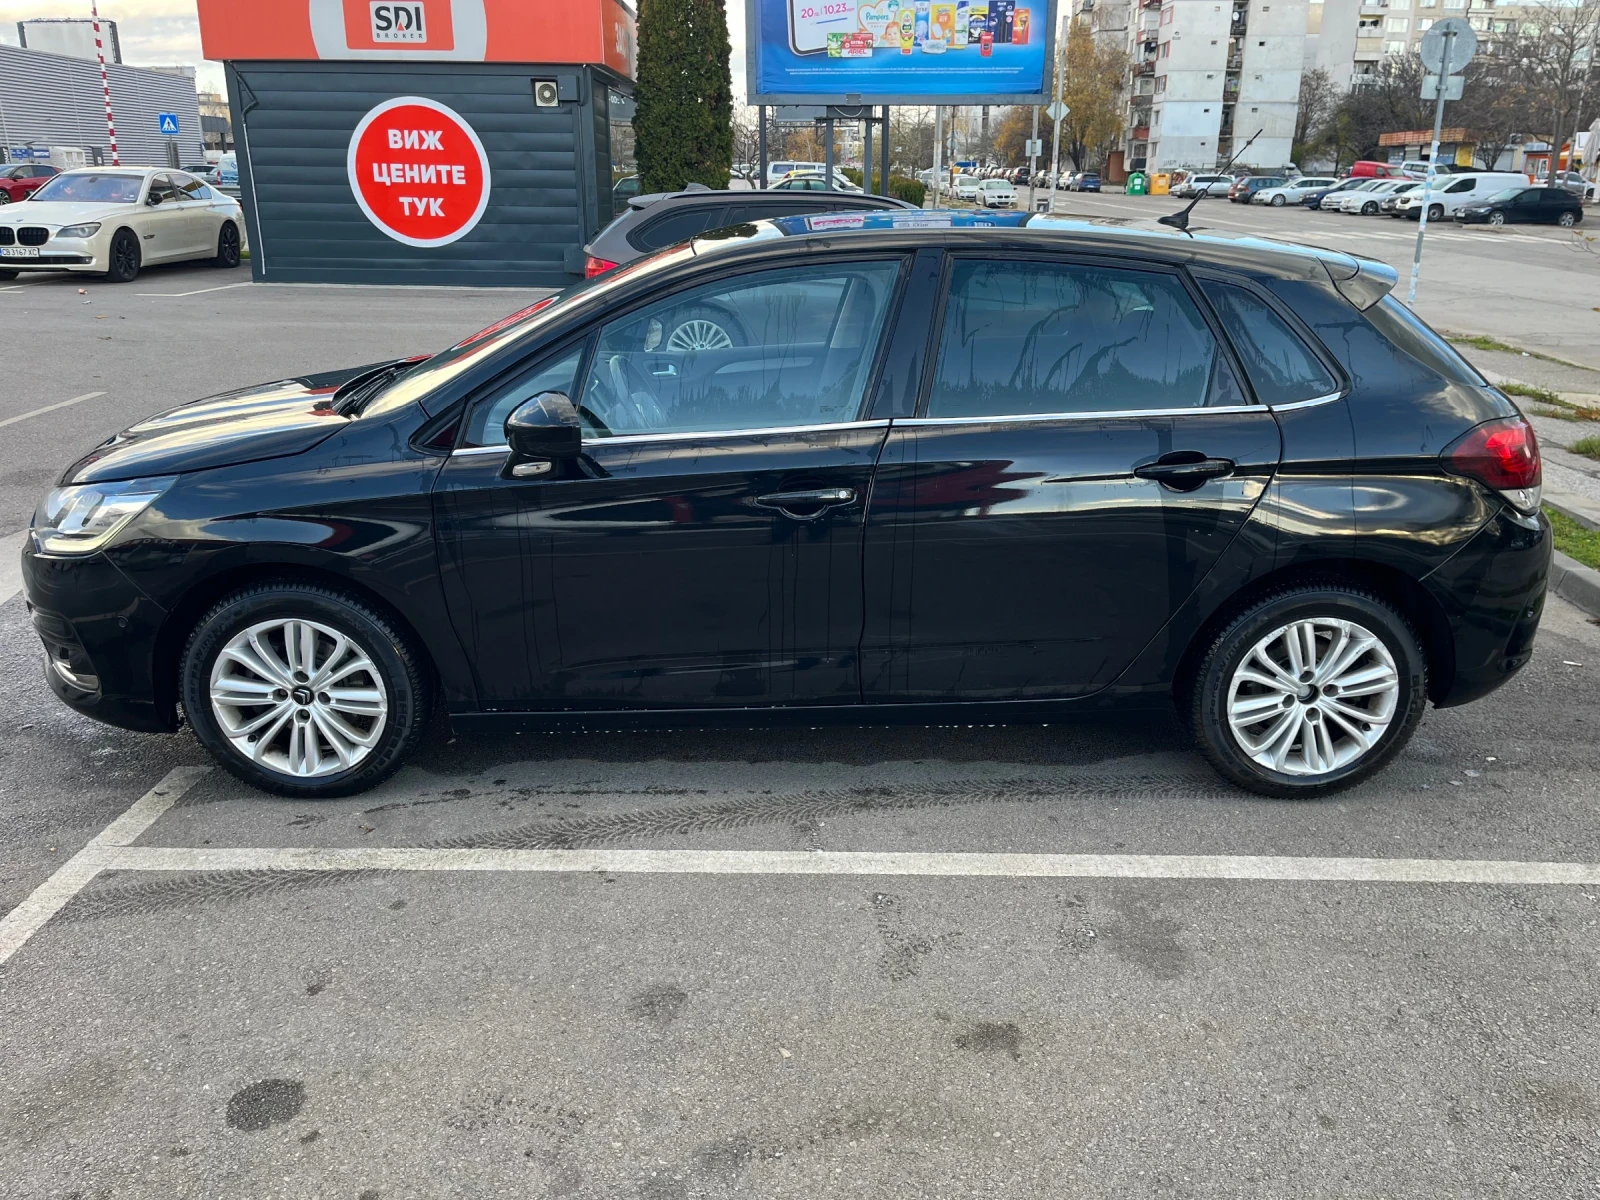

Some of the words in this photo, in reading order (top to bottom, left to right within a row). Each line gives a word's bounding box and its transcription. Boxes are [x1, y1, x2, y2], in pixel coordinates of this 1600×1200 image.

[375, 6, 422, 31] SDI
[801, 8, 814, 18] 20
[866, 12, 889, 21] Pampers
[388, 129, 444, 150] ВИЖ
[372, 163, 466, 186] ЦЕНИТЕ
[399, 196, 445, 217] ТУК
